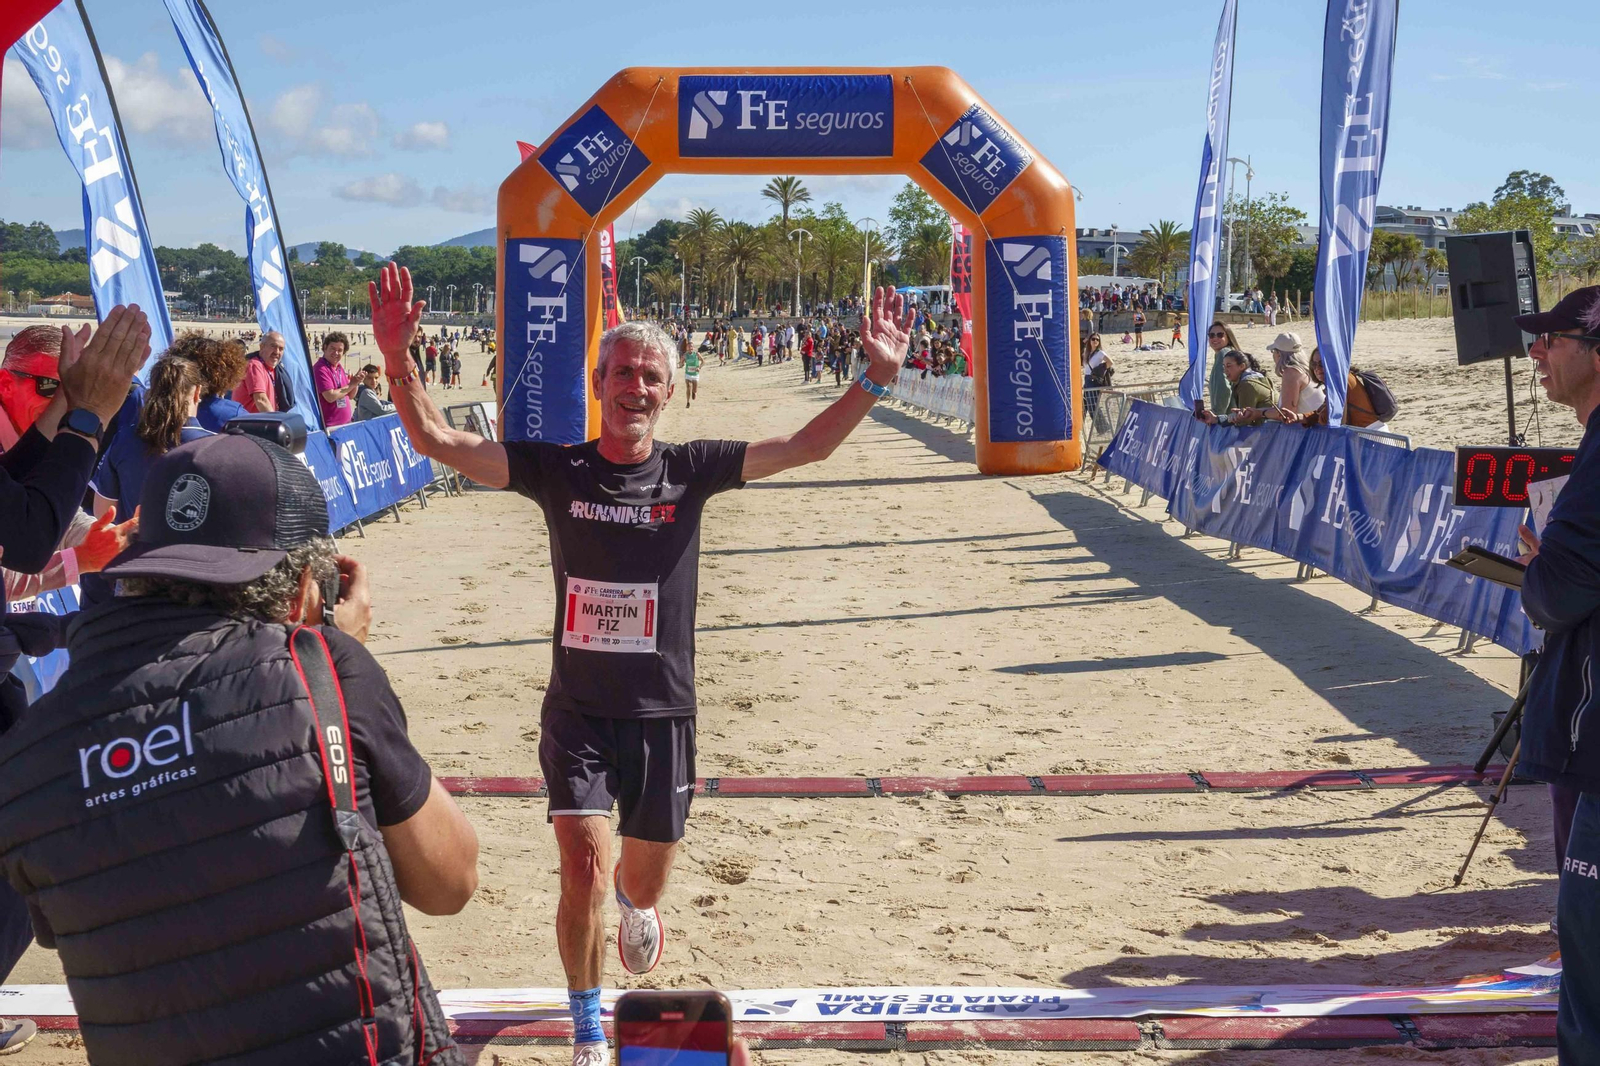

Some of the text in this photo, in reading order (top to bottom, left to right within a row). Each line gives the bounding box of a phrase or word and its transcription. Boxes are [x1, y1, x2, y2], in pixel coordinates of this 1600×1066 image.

[737, 90, 884, 135] FE seguros
[585, 138, 631, 185] seguros
[952, 152, 1000, 196] seguros
[521, 350, 543, 440] seguros
[1009, 347, 1034, 437] seguros
[12, 600, 36, 613] STAFF
[581, 602, 638, 618] MARTÍN
[597, 618, 620, 632] FIZ
[79, 701, 195, 788] roel
[326, 725, 349, 784] EOS
[85, 765, 197, 808] artes gráficas
